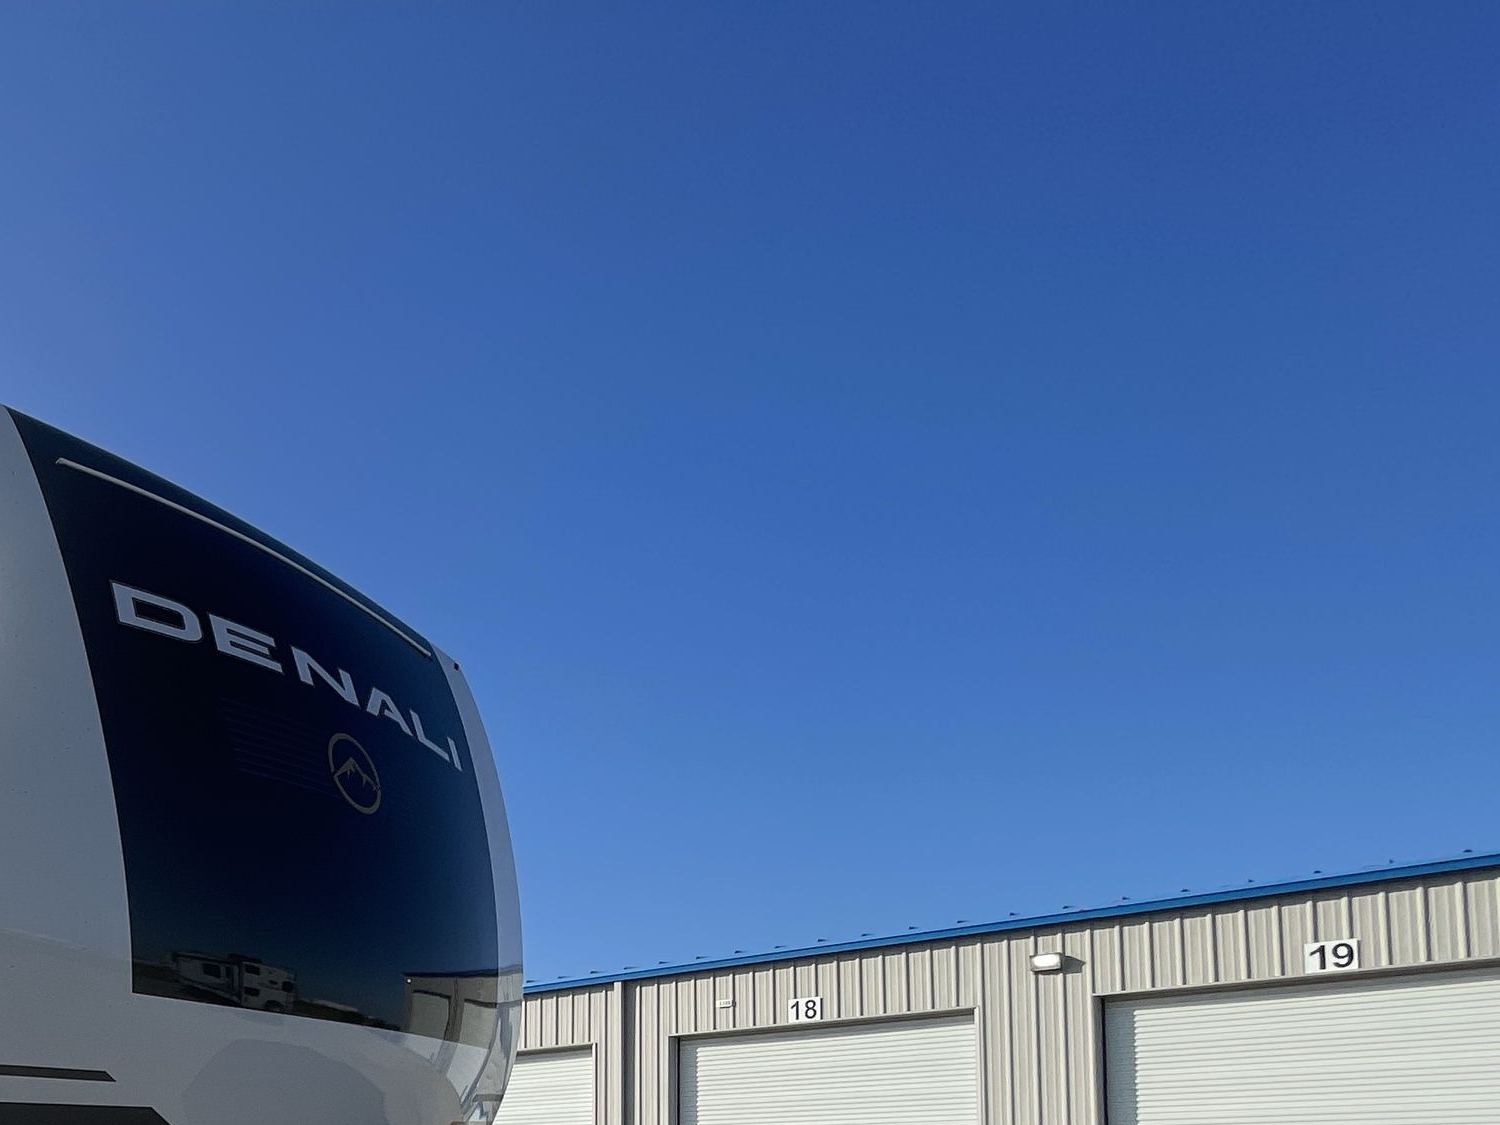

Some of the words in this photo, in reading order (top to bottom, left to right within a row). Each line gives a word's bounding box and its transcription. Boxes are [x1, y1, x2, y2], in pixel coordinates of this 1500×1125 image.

[109, 579, 463, 772] DENALI
[1309, 942, 1354, 970] 19
[790, 999, 817, 1020] 18
